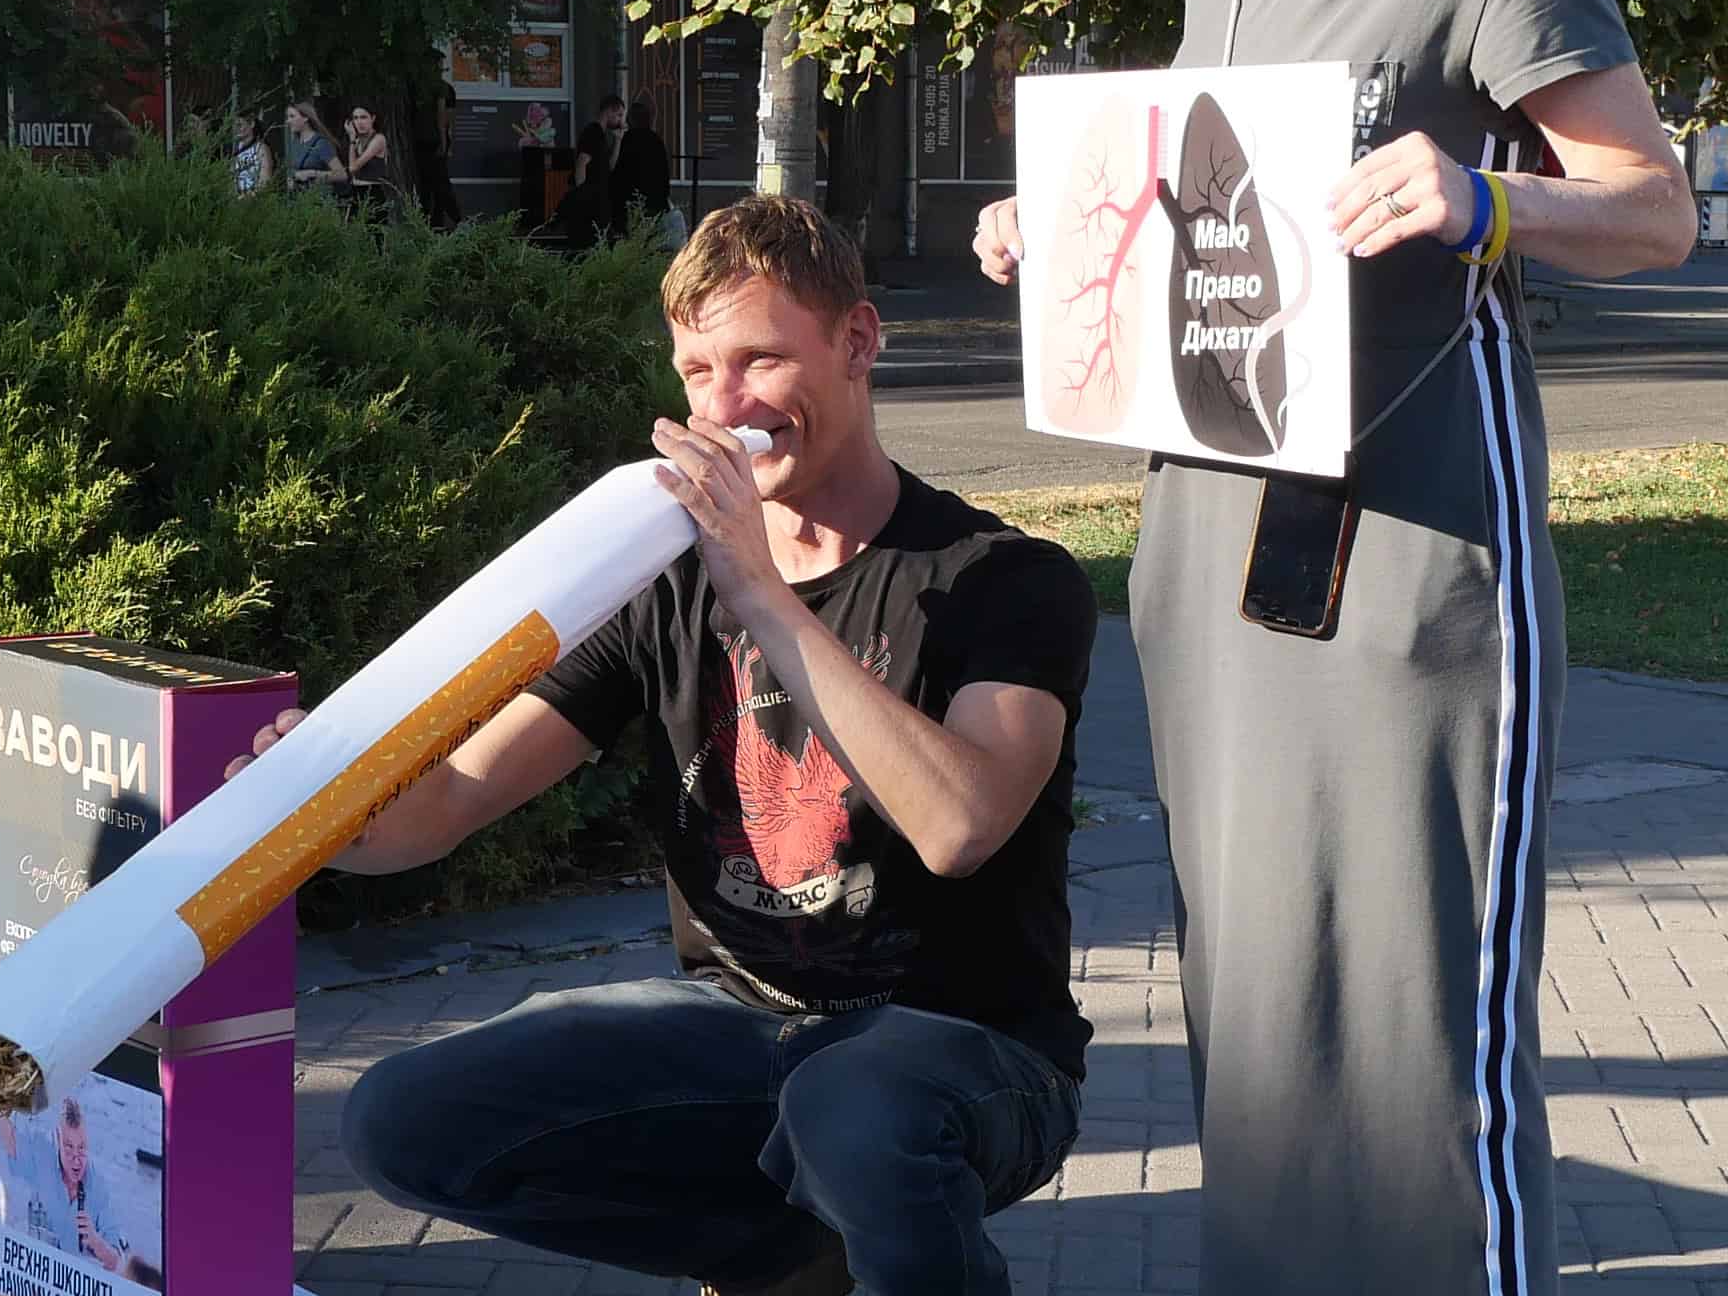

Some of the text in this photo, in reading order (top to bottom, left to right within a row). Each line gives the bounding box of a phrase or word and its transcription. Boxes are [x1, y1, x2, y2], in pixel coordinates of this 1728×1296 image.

[19, 122, 93, 146] NOVELTY
[1194, 218, 1250, 250] Маю
[1185, 270, 1262, 307] Право
[1181, 320, 1267, 356] Дихати
[76, 798, 148, 833] БЕЗ ФІЛЬТРУ
[3, 1237, 50, 1283] БРЕХНЯ
